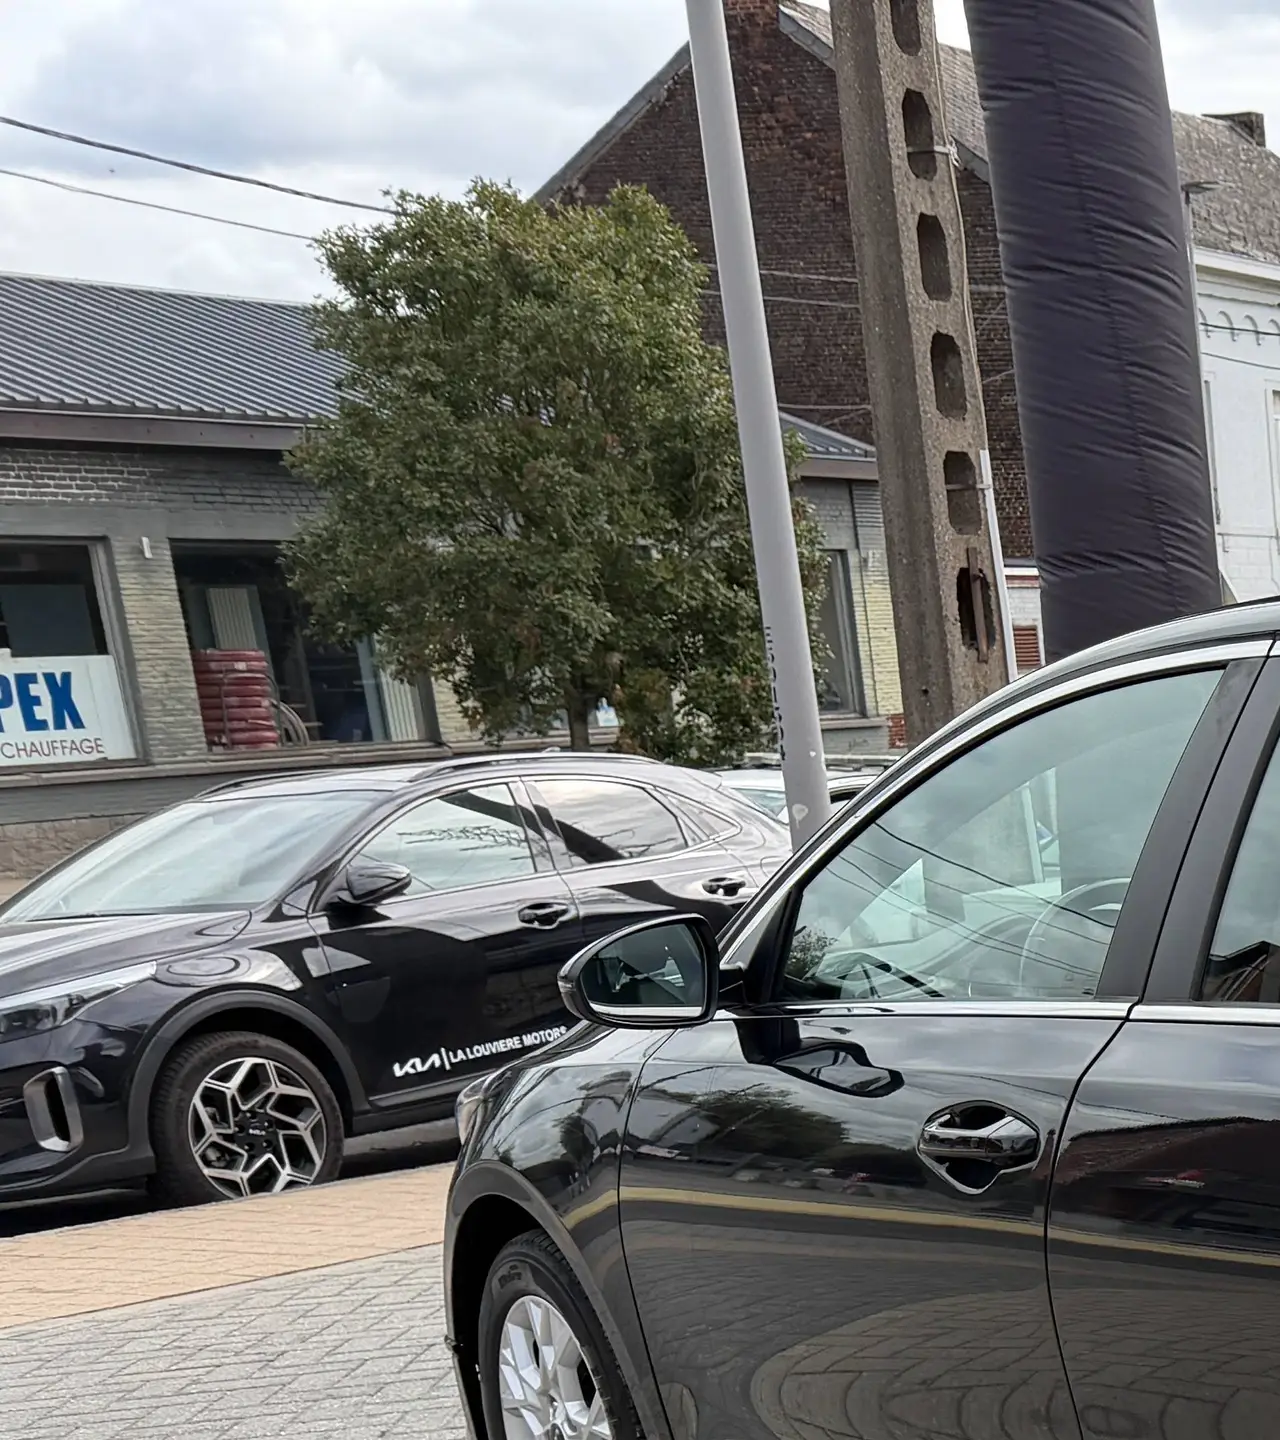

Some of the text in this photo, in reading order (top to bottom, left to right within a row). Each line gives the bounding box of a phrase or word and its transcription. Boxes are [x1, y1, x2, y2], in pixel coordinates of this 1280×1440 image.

[1, 737, 106, 759] CHAUFFAGE
[392, 1052, 442, 1078] KIA
[449, 1049, 467, 1064] LA
[468, 1035, 523, 1059] LOUVIERE
